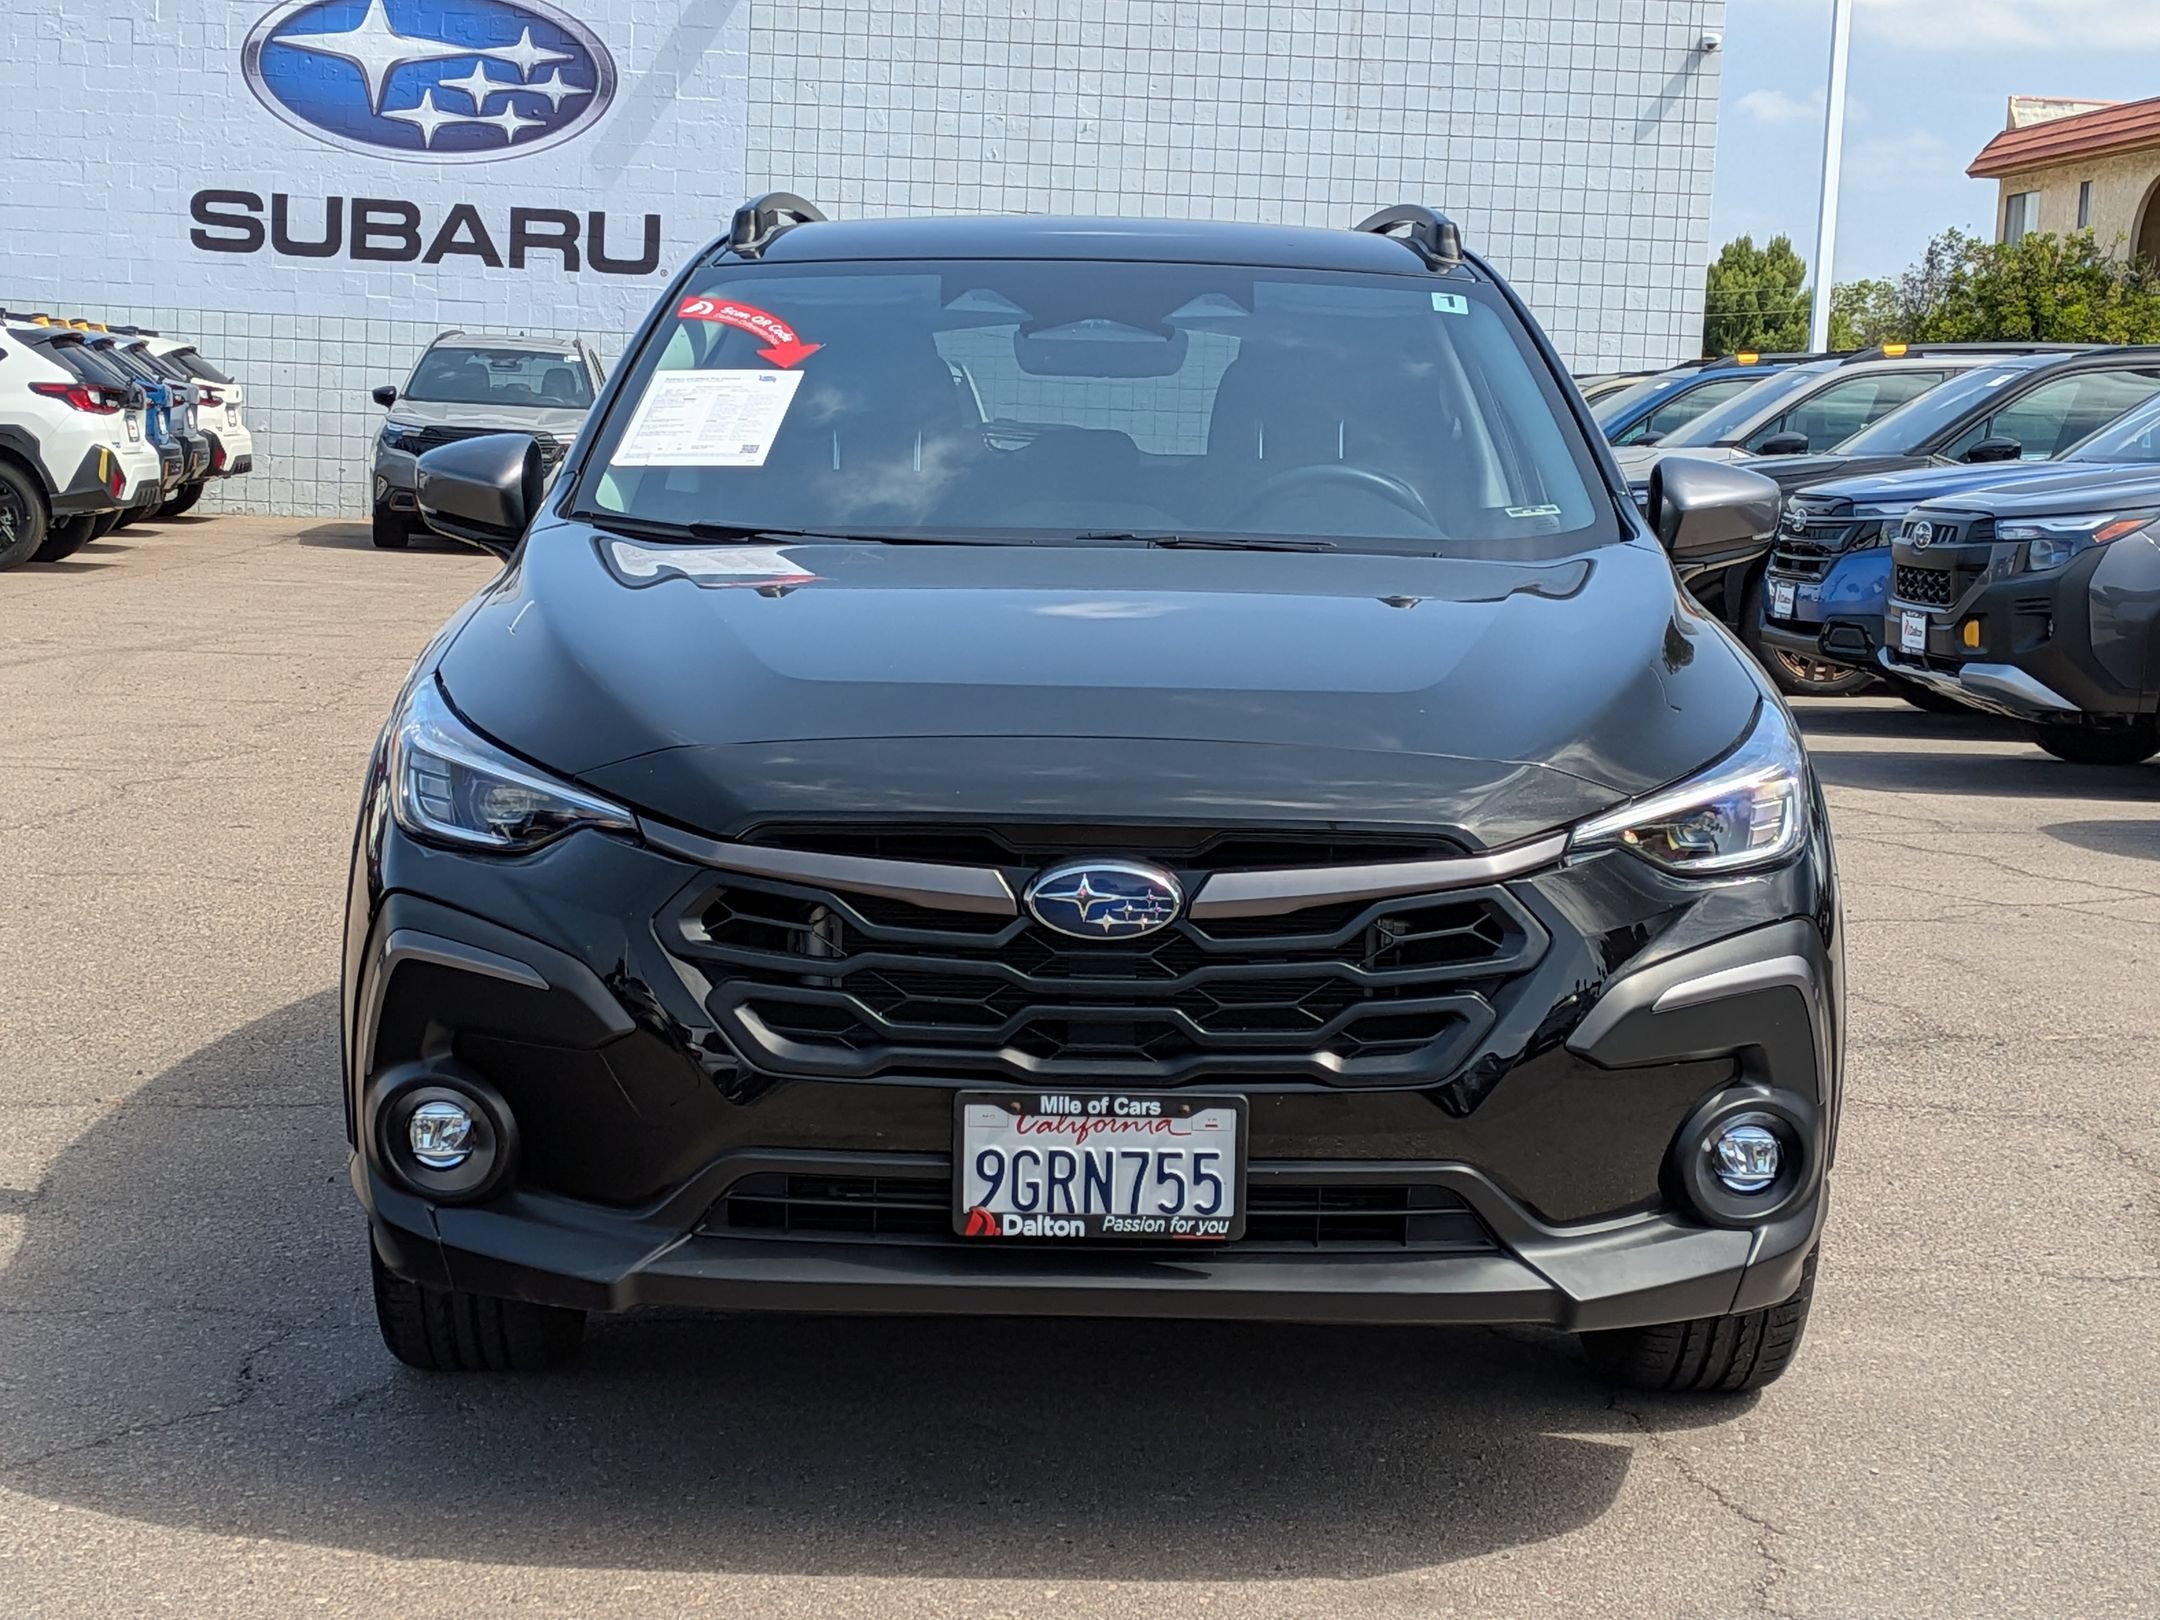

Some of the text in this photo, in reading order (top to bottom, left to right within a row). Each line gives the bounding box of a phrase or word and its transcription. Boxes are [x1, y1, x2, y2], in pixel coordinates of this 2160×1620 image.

[190, 189, 661, 275] SUBARU
[720, 306, 751, 319] Scan
[751, 315, 773, 327] QR
[768, 324, 793, 342] Code
[1040, 1095, 1161, 1115] Mile of Cars
[1016, 1113, 1191, 1145] California
[976, 1148, 1222, 1215] 9GRN755
[1003, 1214, 1085, 1236] Dalton
[1103, 1216, 1229, 1235] Passion for you
